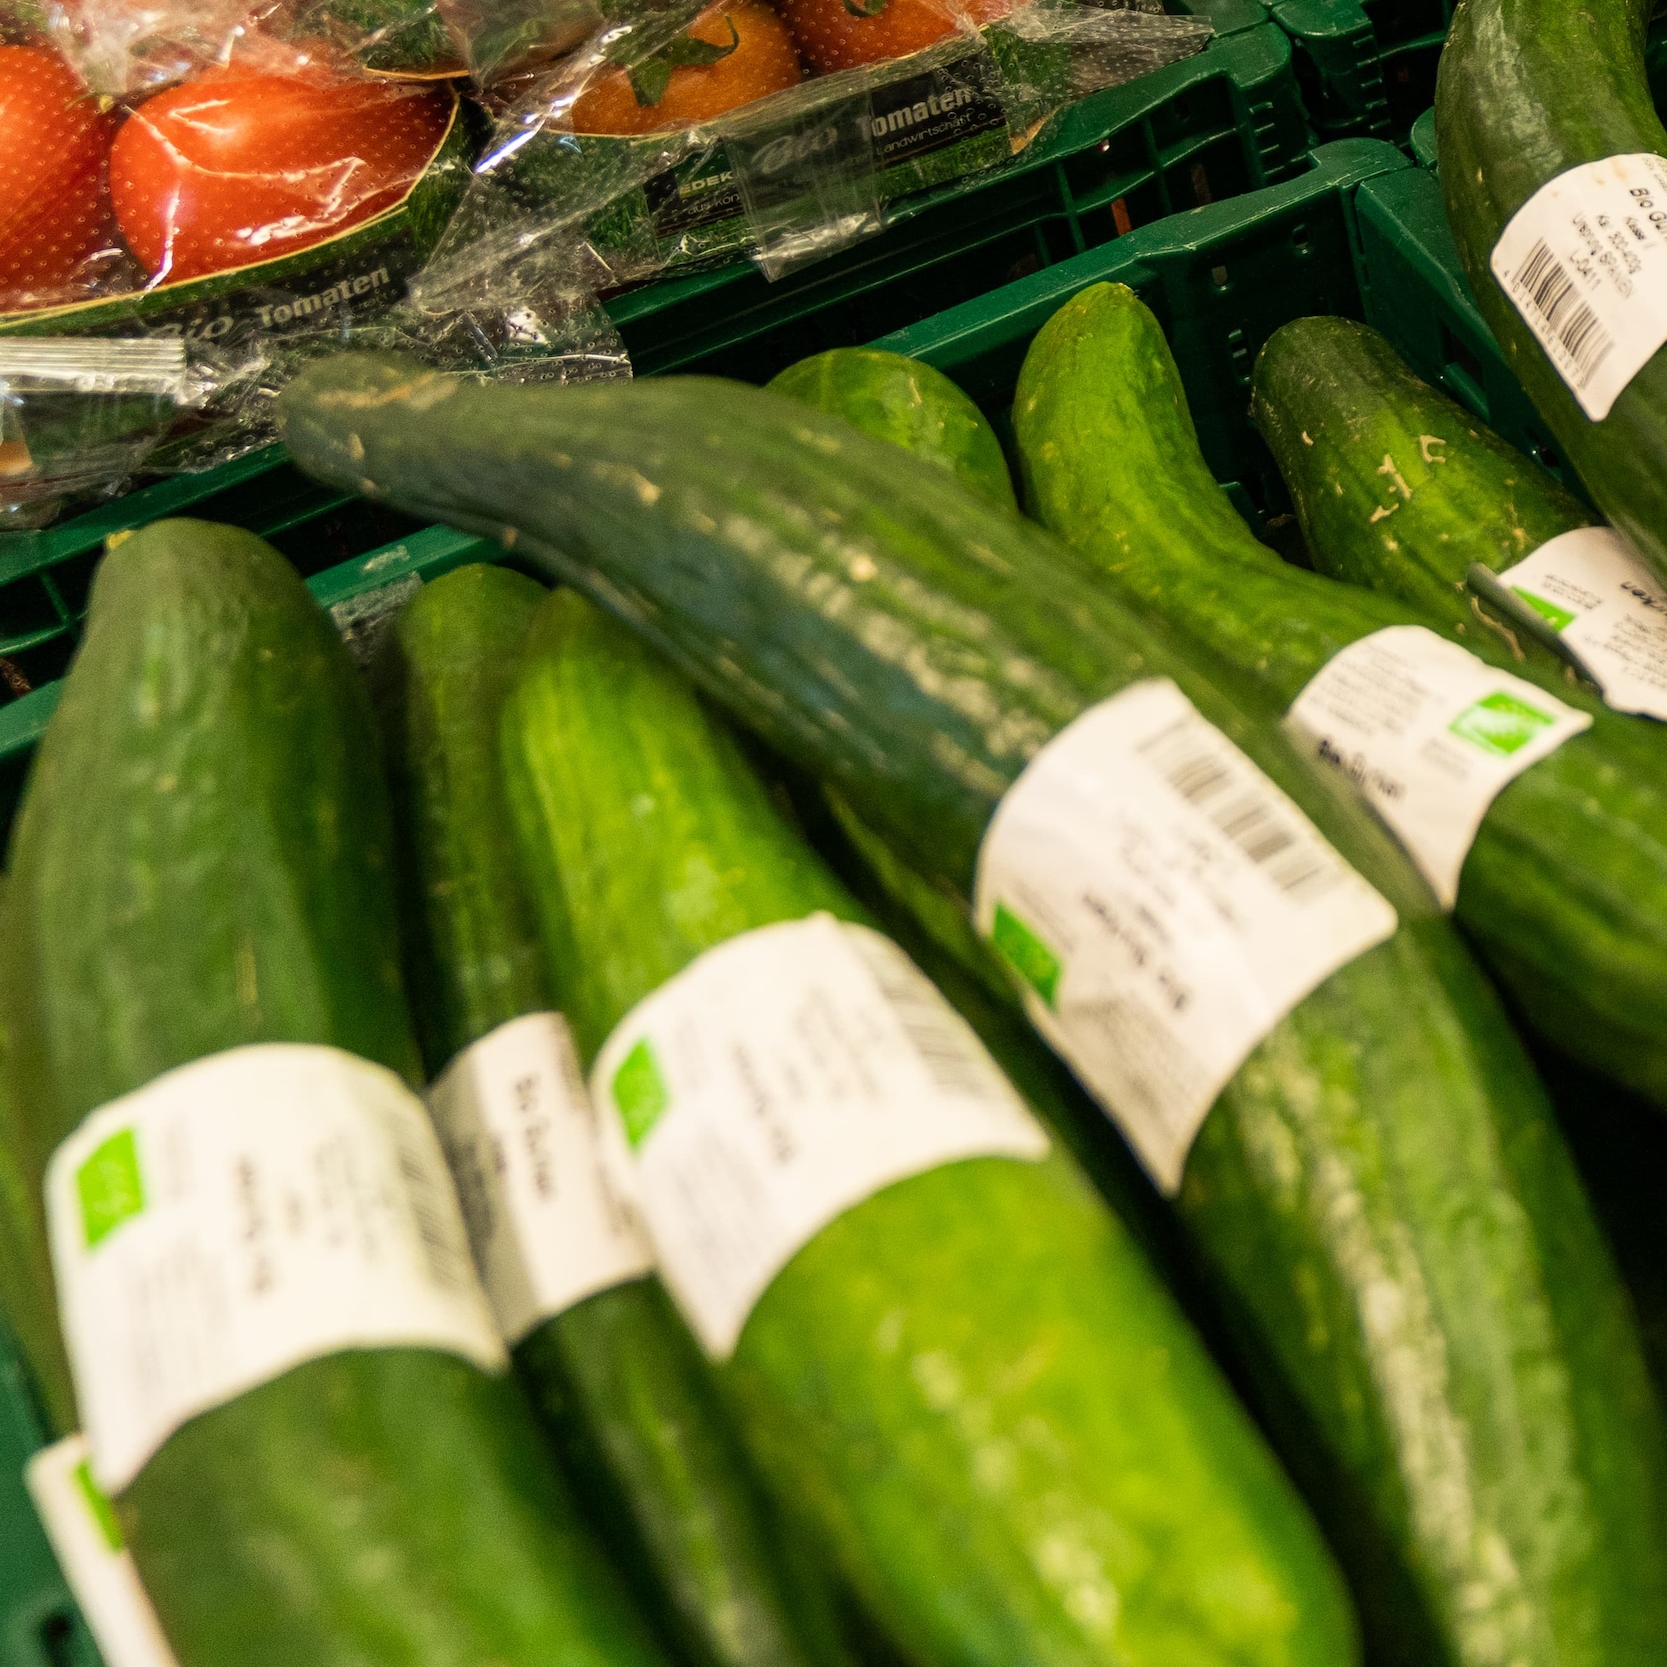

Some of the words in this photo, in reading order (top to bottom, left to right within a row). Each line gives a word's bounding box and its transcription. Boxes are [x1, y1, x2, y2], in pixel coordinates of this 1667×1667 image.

[678, 170, 735, 199] EDEK
[1628, 186, 1653, 209] Bio
[255, 266, 392, 330] Tomaten
